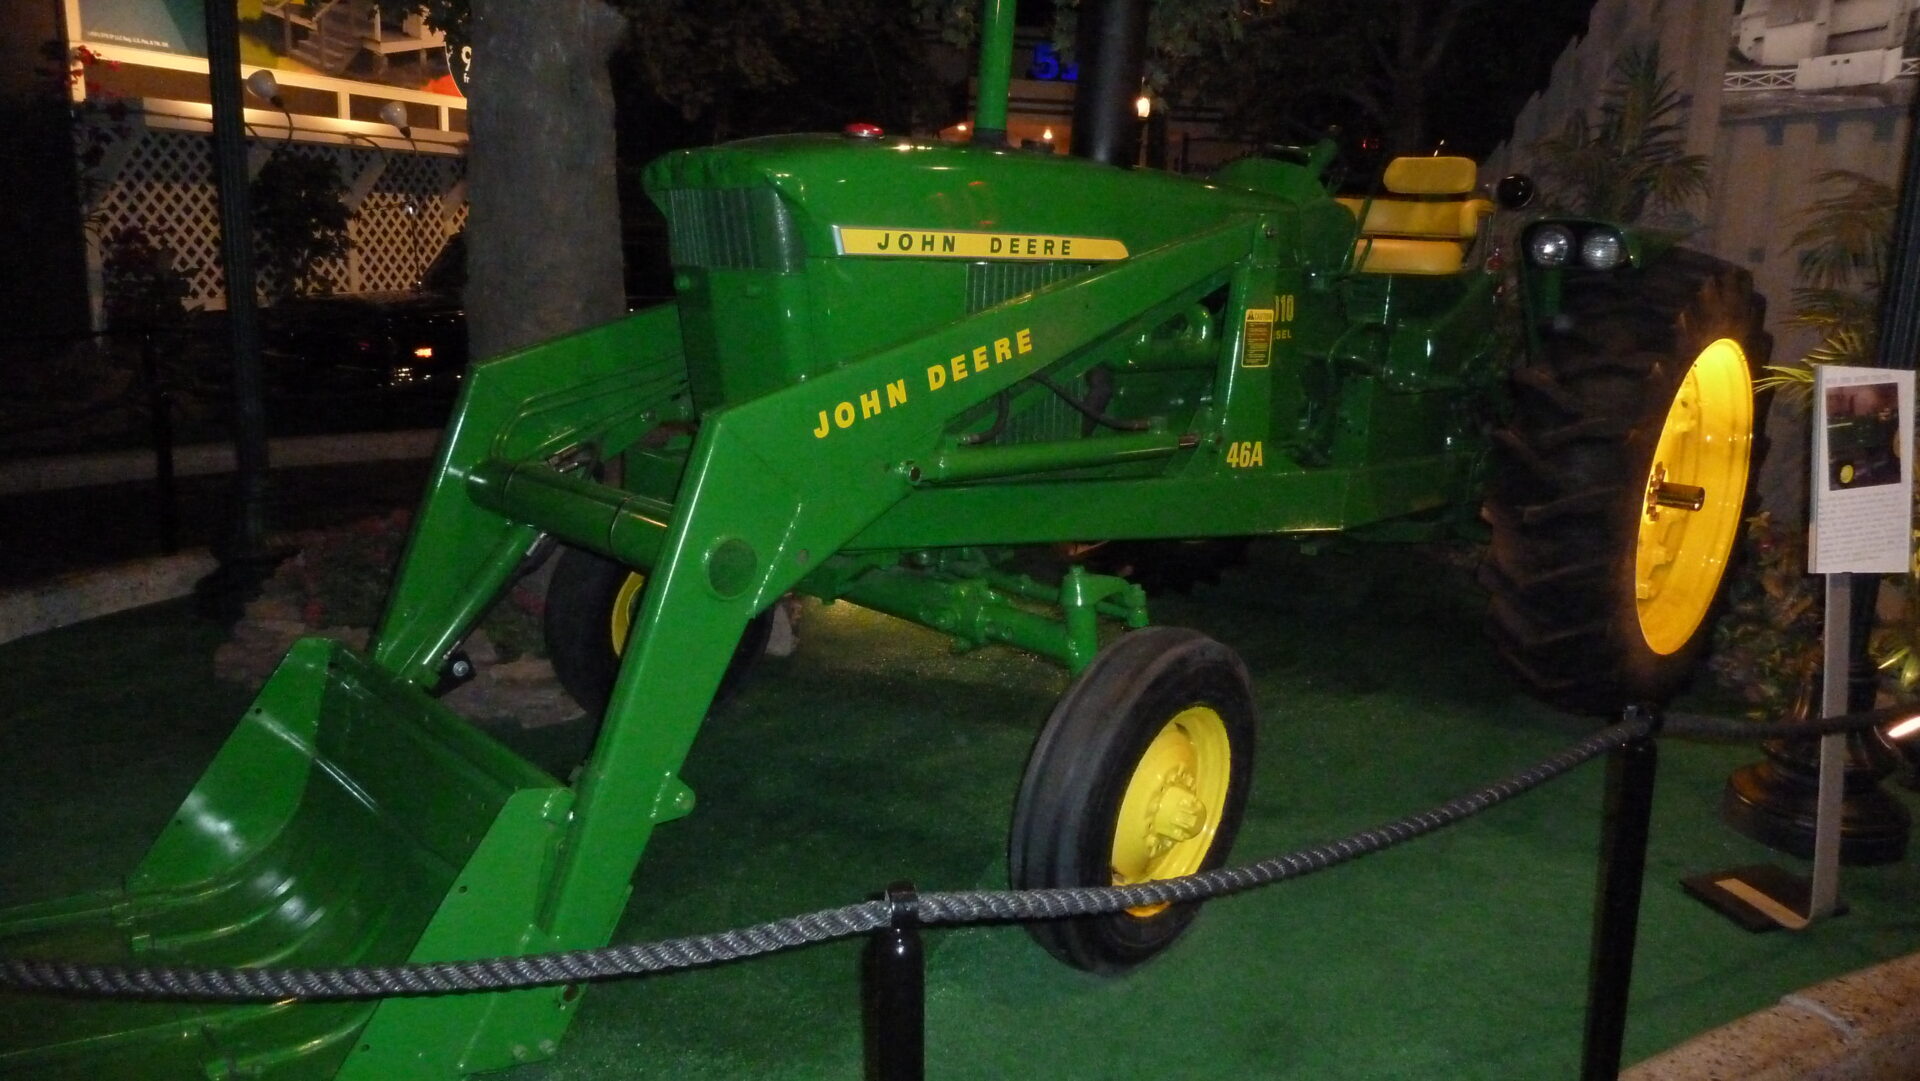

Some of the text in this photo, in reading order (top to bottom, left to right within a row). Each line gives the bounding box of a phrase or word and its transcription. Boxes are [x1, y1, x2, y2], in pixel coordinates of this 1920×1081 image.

[877, 233, 1072, 256] JOHN DEERE
[813, 328, 1033, 439] JOHN DEERE
[1226, 441, 1264, 468] 46A
